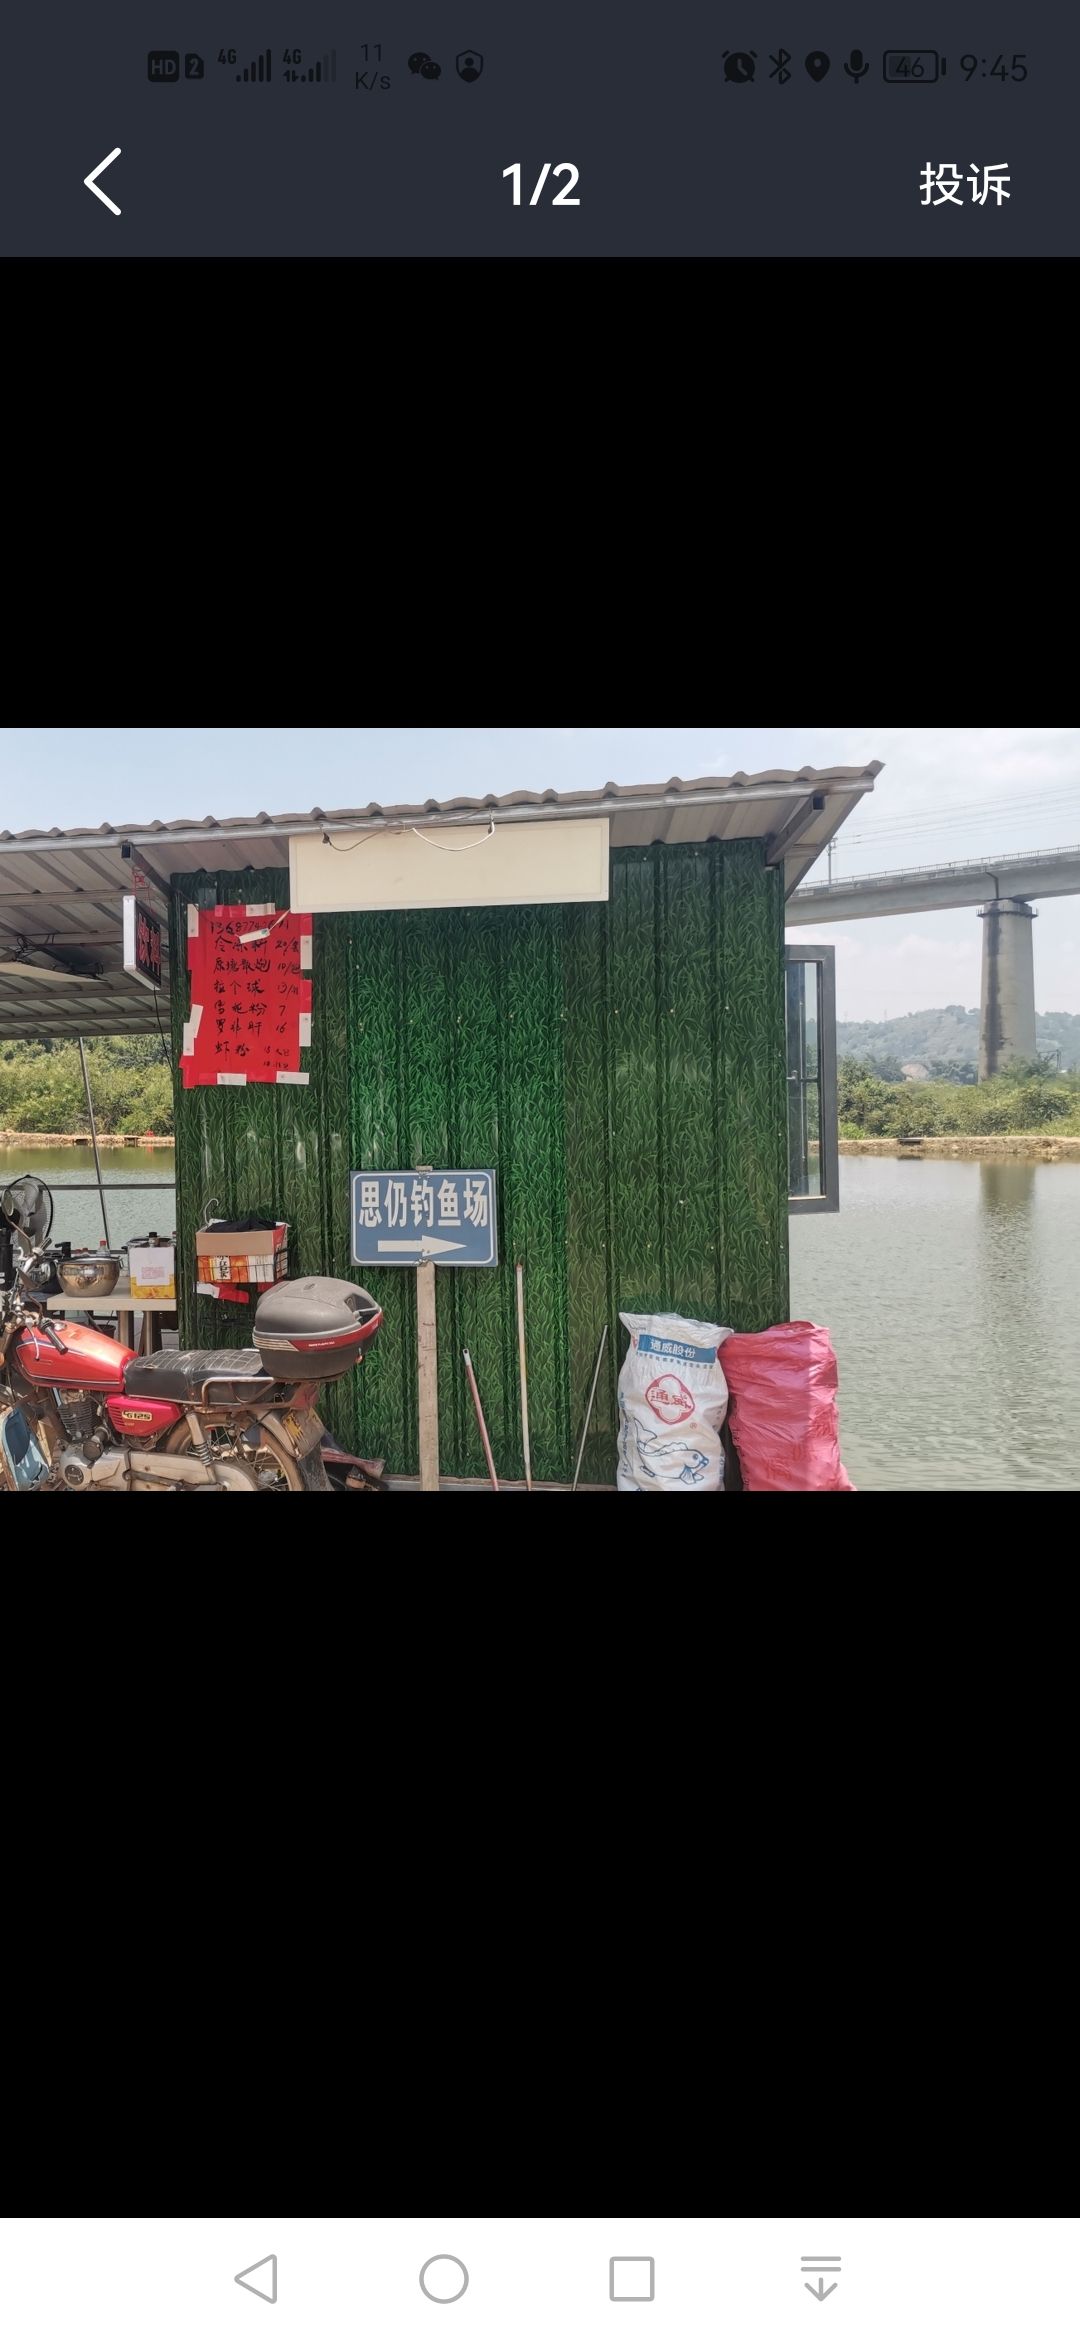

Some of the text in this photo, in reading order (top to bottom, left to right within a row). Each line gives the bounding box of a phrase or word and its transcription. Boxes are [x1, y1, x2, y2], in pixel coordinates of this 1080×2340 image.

[279, 1005, 286, 1016] 7
[358, 1178, 488, 1228] 思仍钓鱼场
[650, 1337, 696, 1358] 通威股份
